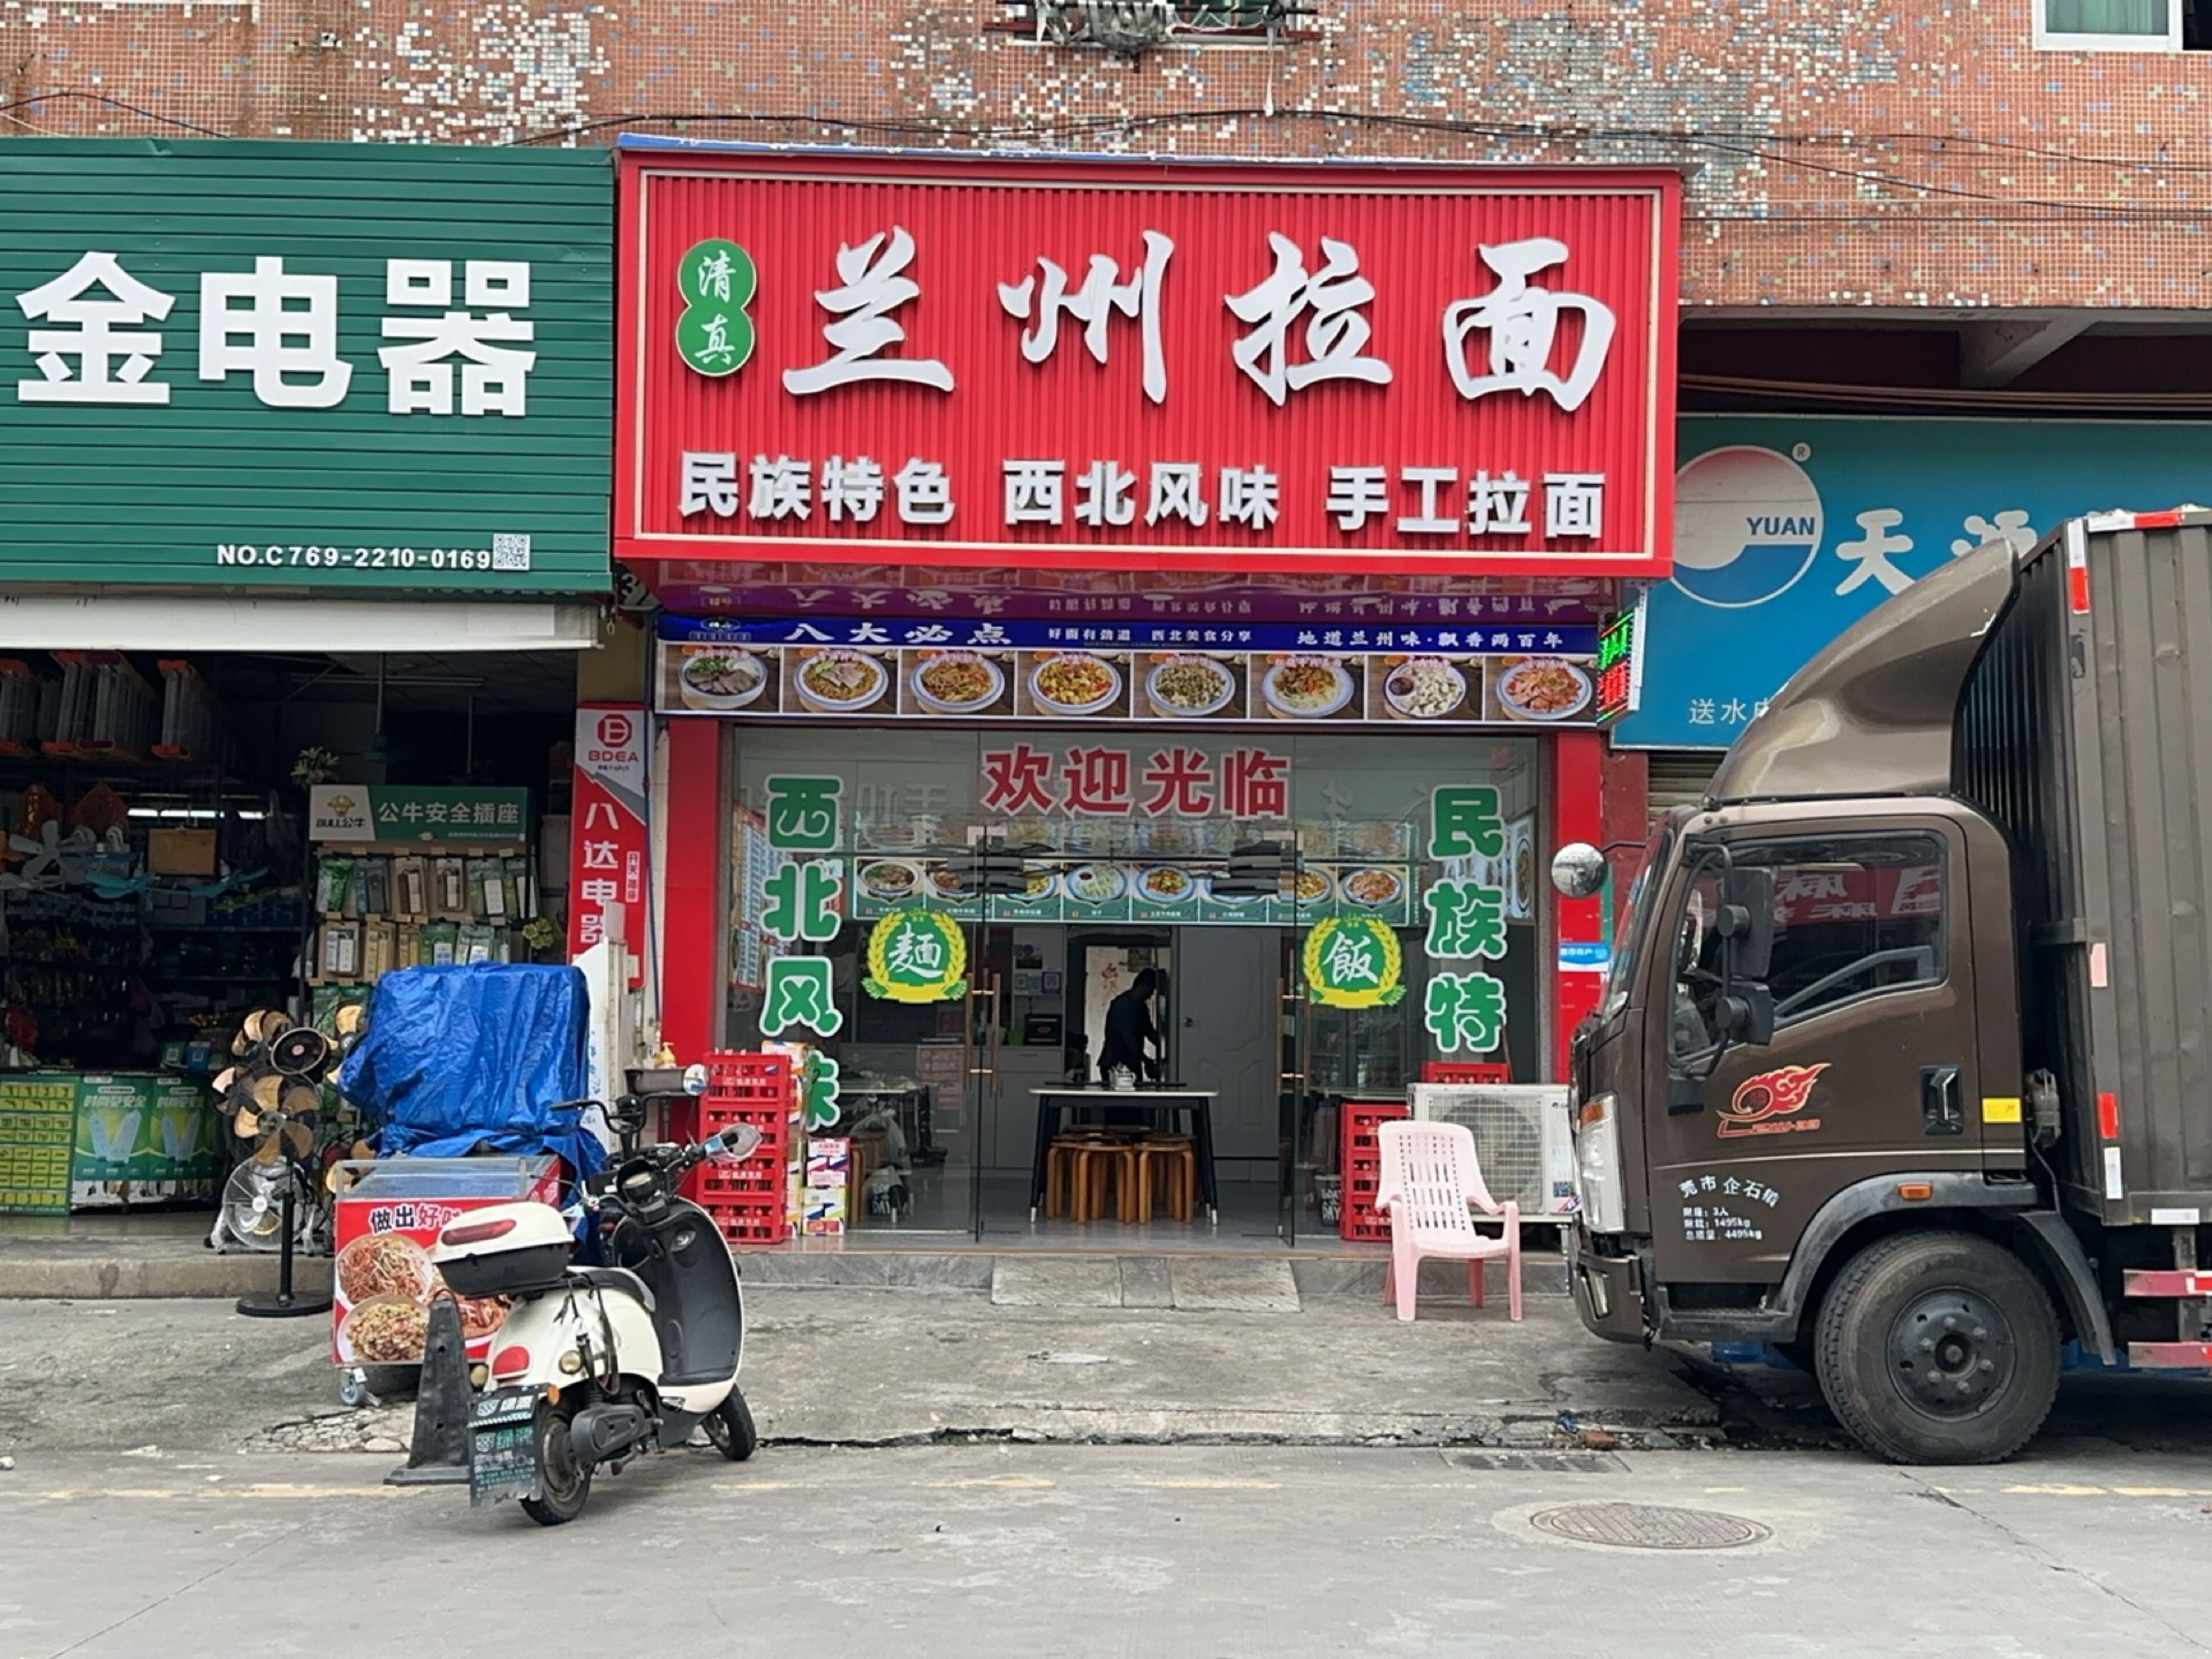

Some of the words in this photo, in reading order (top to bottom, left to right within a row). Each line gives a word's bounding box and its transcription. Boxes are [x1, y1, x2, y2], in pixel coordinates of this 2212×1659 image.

[15, 252, 536, 416] 金电器
[694, 248, 737, 365] 清真
[782, 225, 1617, 412] 兰州拉面
[678, 451, 955, 525] 民族特色
[1003, 460, 1280, 530] 西北风味
[1325, 465, 1605, 539] 手工拉面
[1746, 517, 1815, 536] YUAN
[784, 622, 1012, 645] 八大必点
[588, 750, 639, 762] BDEA
[982, 743, 1290, 821] 欢迎光临
[378, 801, 518, 824] 公牛安全插座
[1423, 784, 1509, 1054] 民族特
